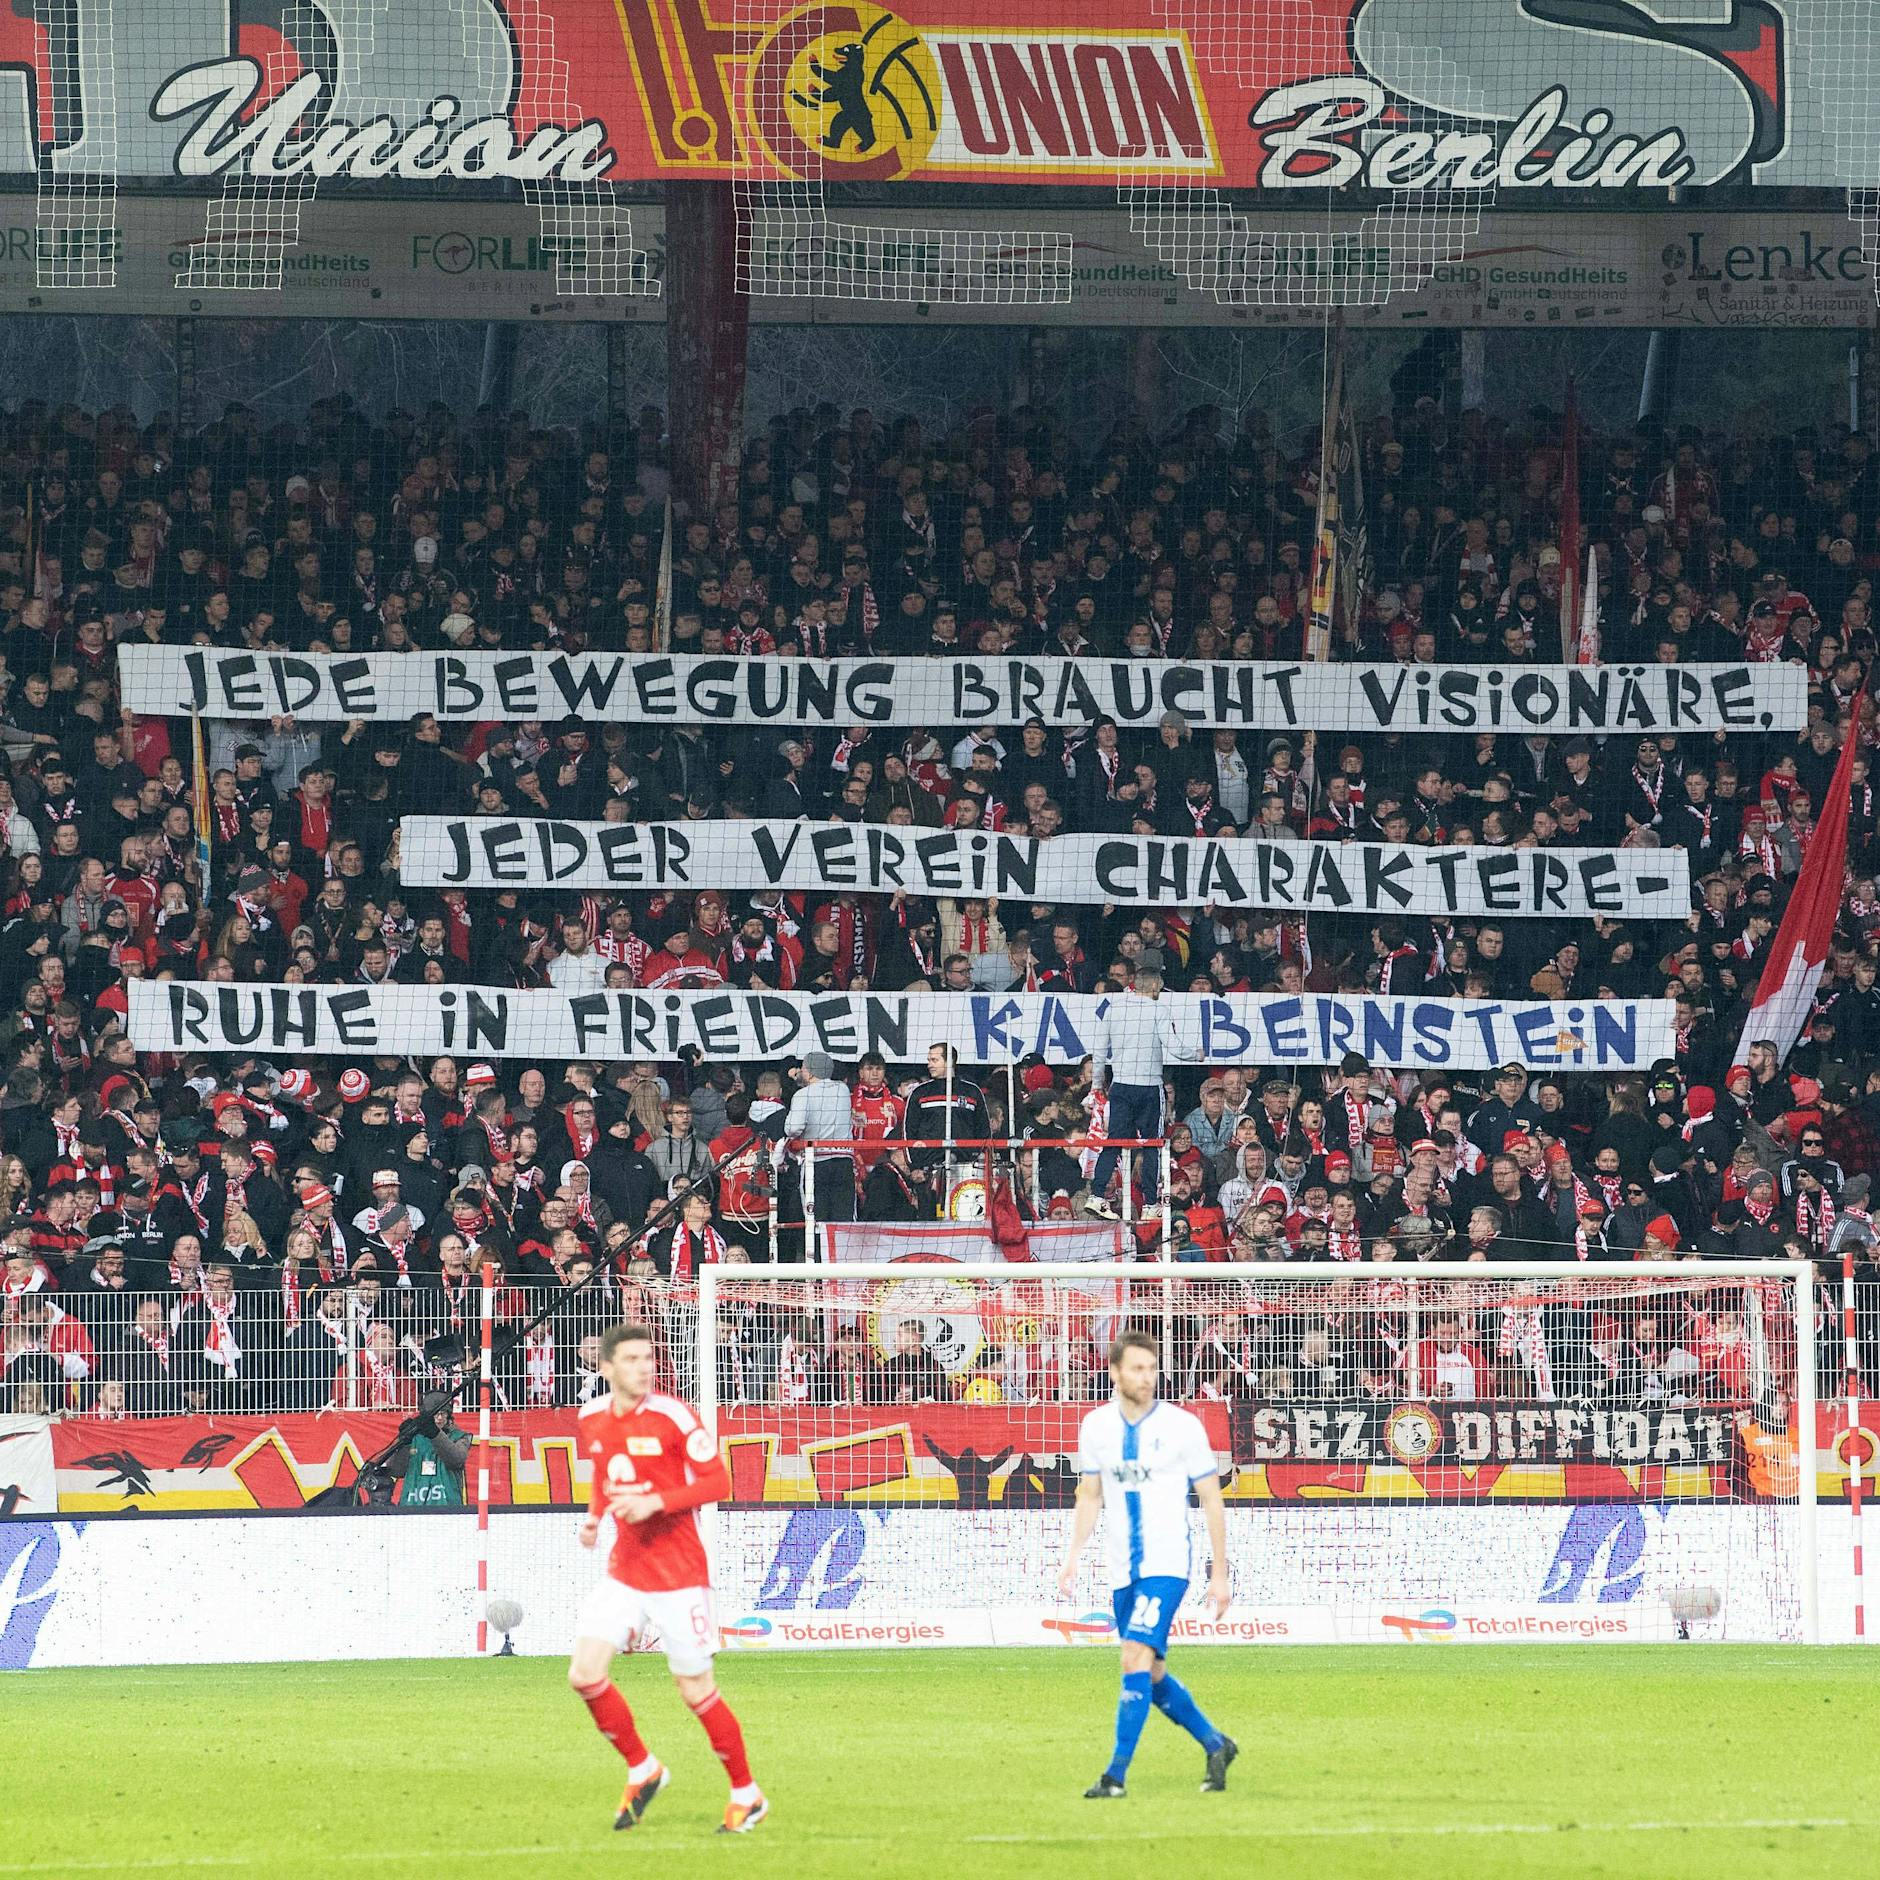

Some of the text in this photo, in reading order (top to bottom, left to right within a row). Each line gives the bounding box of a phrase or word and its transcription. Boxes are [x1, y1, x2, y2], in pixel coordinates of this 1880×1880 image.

[149, 56, 616, 178] Union
[937, 43, 1207, 158] UNION
[1250, 83, 1693, 188] Berlin
[0, 228, 123, 262] RLIFE
[412, 232, 587, 273] FORLIFE
[766, 238, 940, 279] FORLIFE
[1219, 241, 1390, 283] FORLIFE
[1688, 231, 1868, 281] Lenke
[280, 275, 370, 289] Deutschland
[469, 283, 538, 293] BERLIN
[1088, 285, 1177, 298] Deutschland
[1434, 267, 1628, 284] GHD GesundHeits
[1538, 288, 1627, 300] eutschland
[1720, 297, 1778, 311] Sanitär
[1801, 297, 1869, 314] Heizung
[179, 651, 378, 714] JEDE
[436, 655, 896, 720] BEWEGUNG
[953, 661, 1301, 727] BRAUCHT
[444, 823, 690, 883] JEDER
[1096, 841, 1669, 911] CHARAKTERE-
[170, 986, 378, 1046] RUHE
[1254, 1408, 1385, 1459] SEZ.
[407, 1484, 447, 1503] HOST
[690, 1604, 709, 1637] 6
[1130, 1594, 1162, 1629] 26
[1463, 1615, 1628, 1637] TotalEnergies
[778, 1621, 944, 1643] TotalEnergies
[1170, 1618, 1288, 1640] alEnergies
